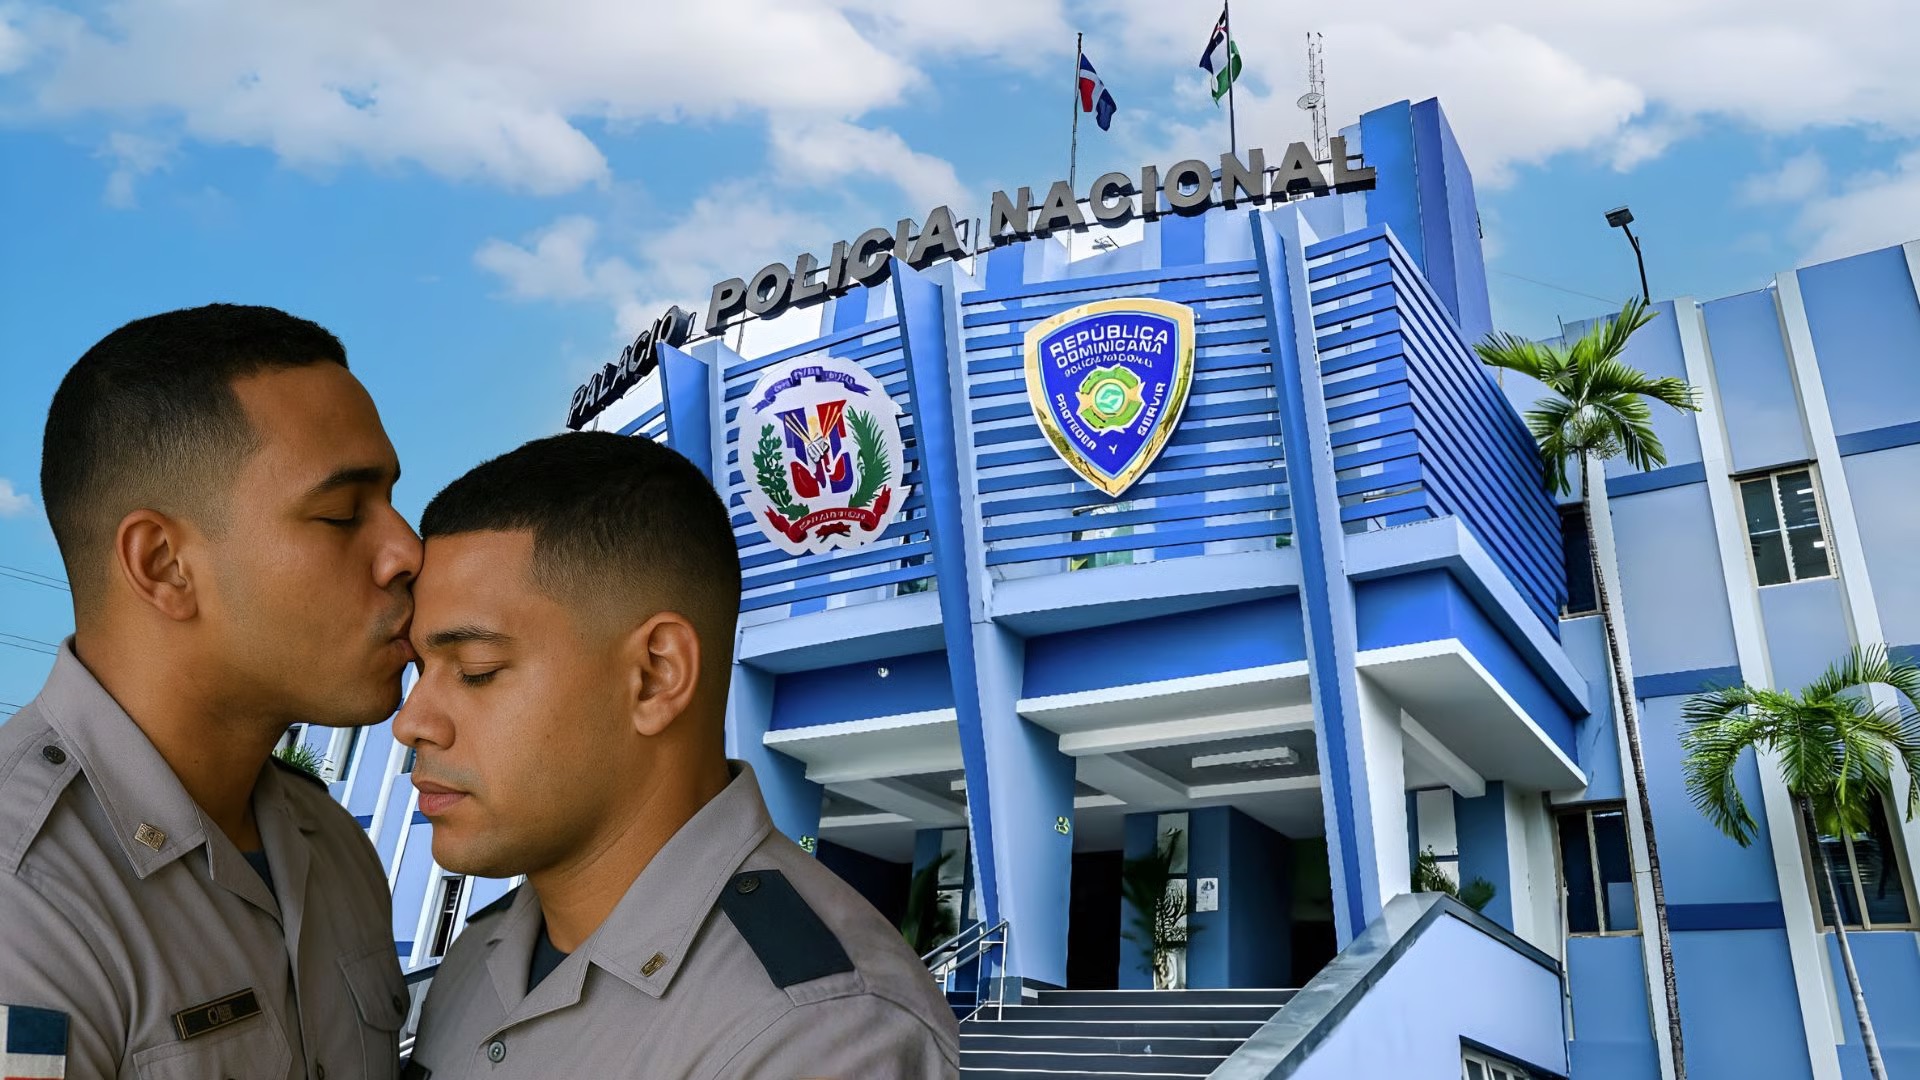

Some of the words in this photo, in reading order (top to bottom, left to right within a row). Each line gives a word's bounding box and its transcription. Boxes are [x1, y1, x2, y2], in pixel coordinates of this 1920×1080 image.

[566, 305, 687, 429] PALACIO
[705, 205, 968, 335] POLICIA
[989, 135, 1377, 242] NACIONAL
[1049, 322, 1168, 358] REPÚBLICA
[1056, 339, 1162, 369] DOMINICANA
[1108, 444, 1118, 455] Y
